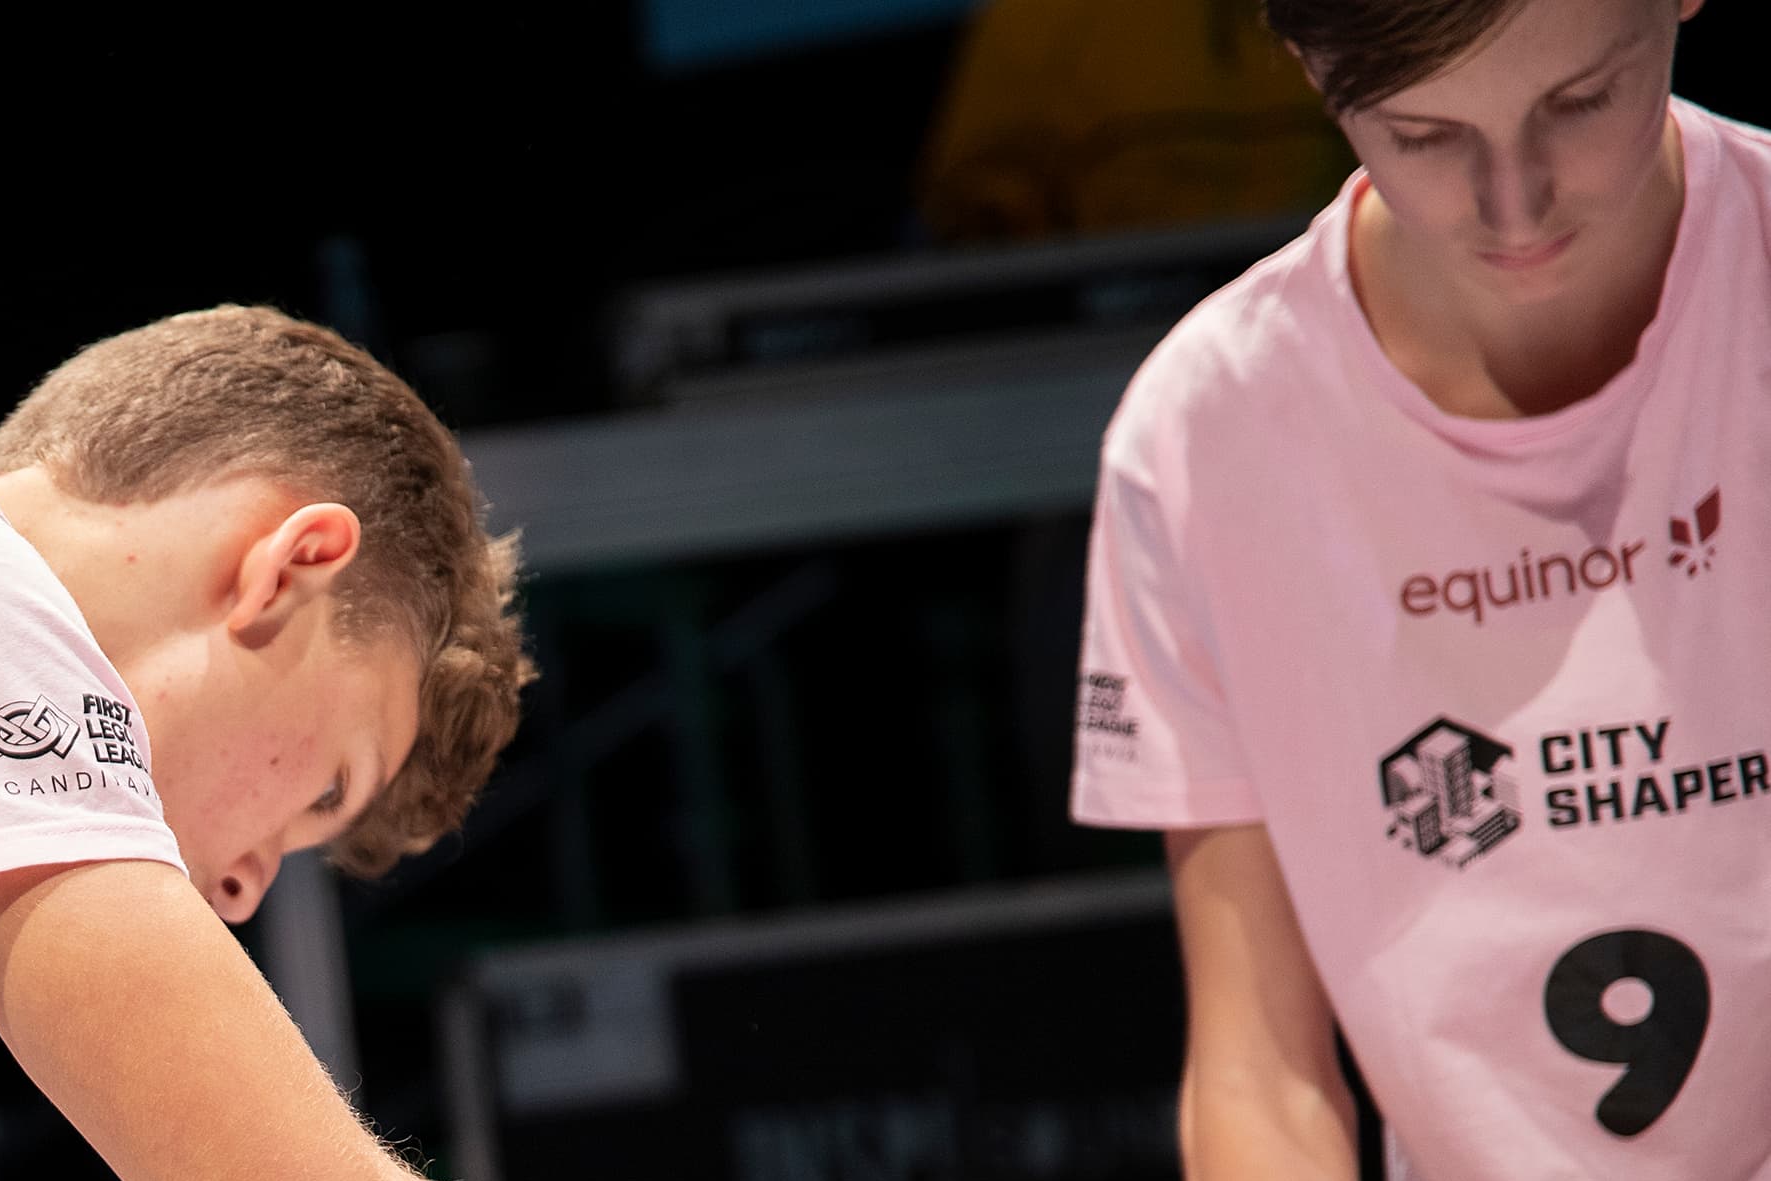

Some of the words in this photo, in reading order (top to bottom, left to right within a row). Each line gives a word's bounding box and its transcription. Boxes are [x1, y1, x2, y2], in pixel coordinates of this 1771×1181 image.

[1399, 541, 1646, 626] equinor
[92, 741, 149, 775] LEAG
[1539, 716, 1672, 776] CITY
[1545, 750, 1771, 830] SHAPER
[1542, 928, 1713, 1138] 9
